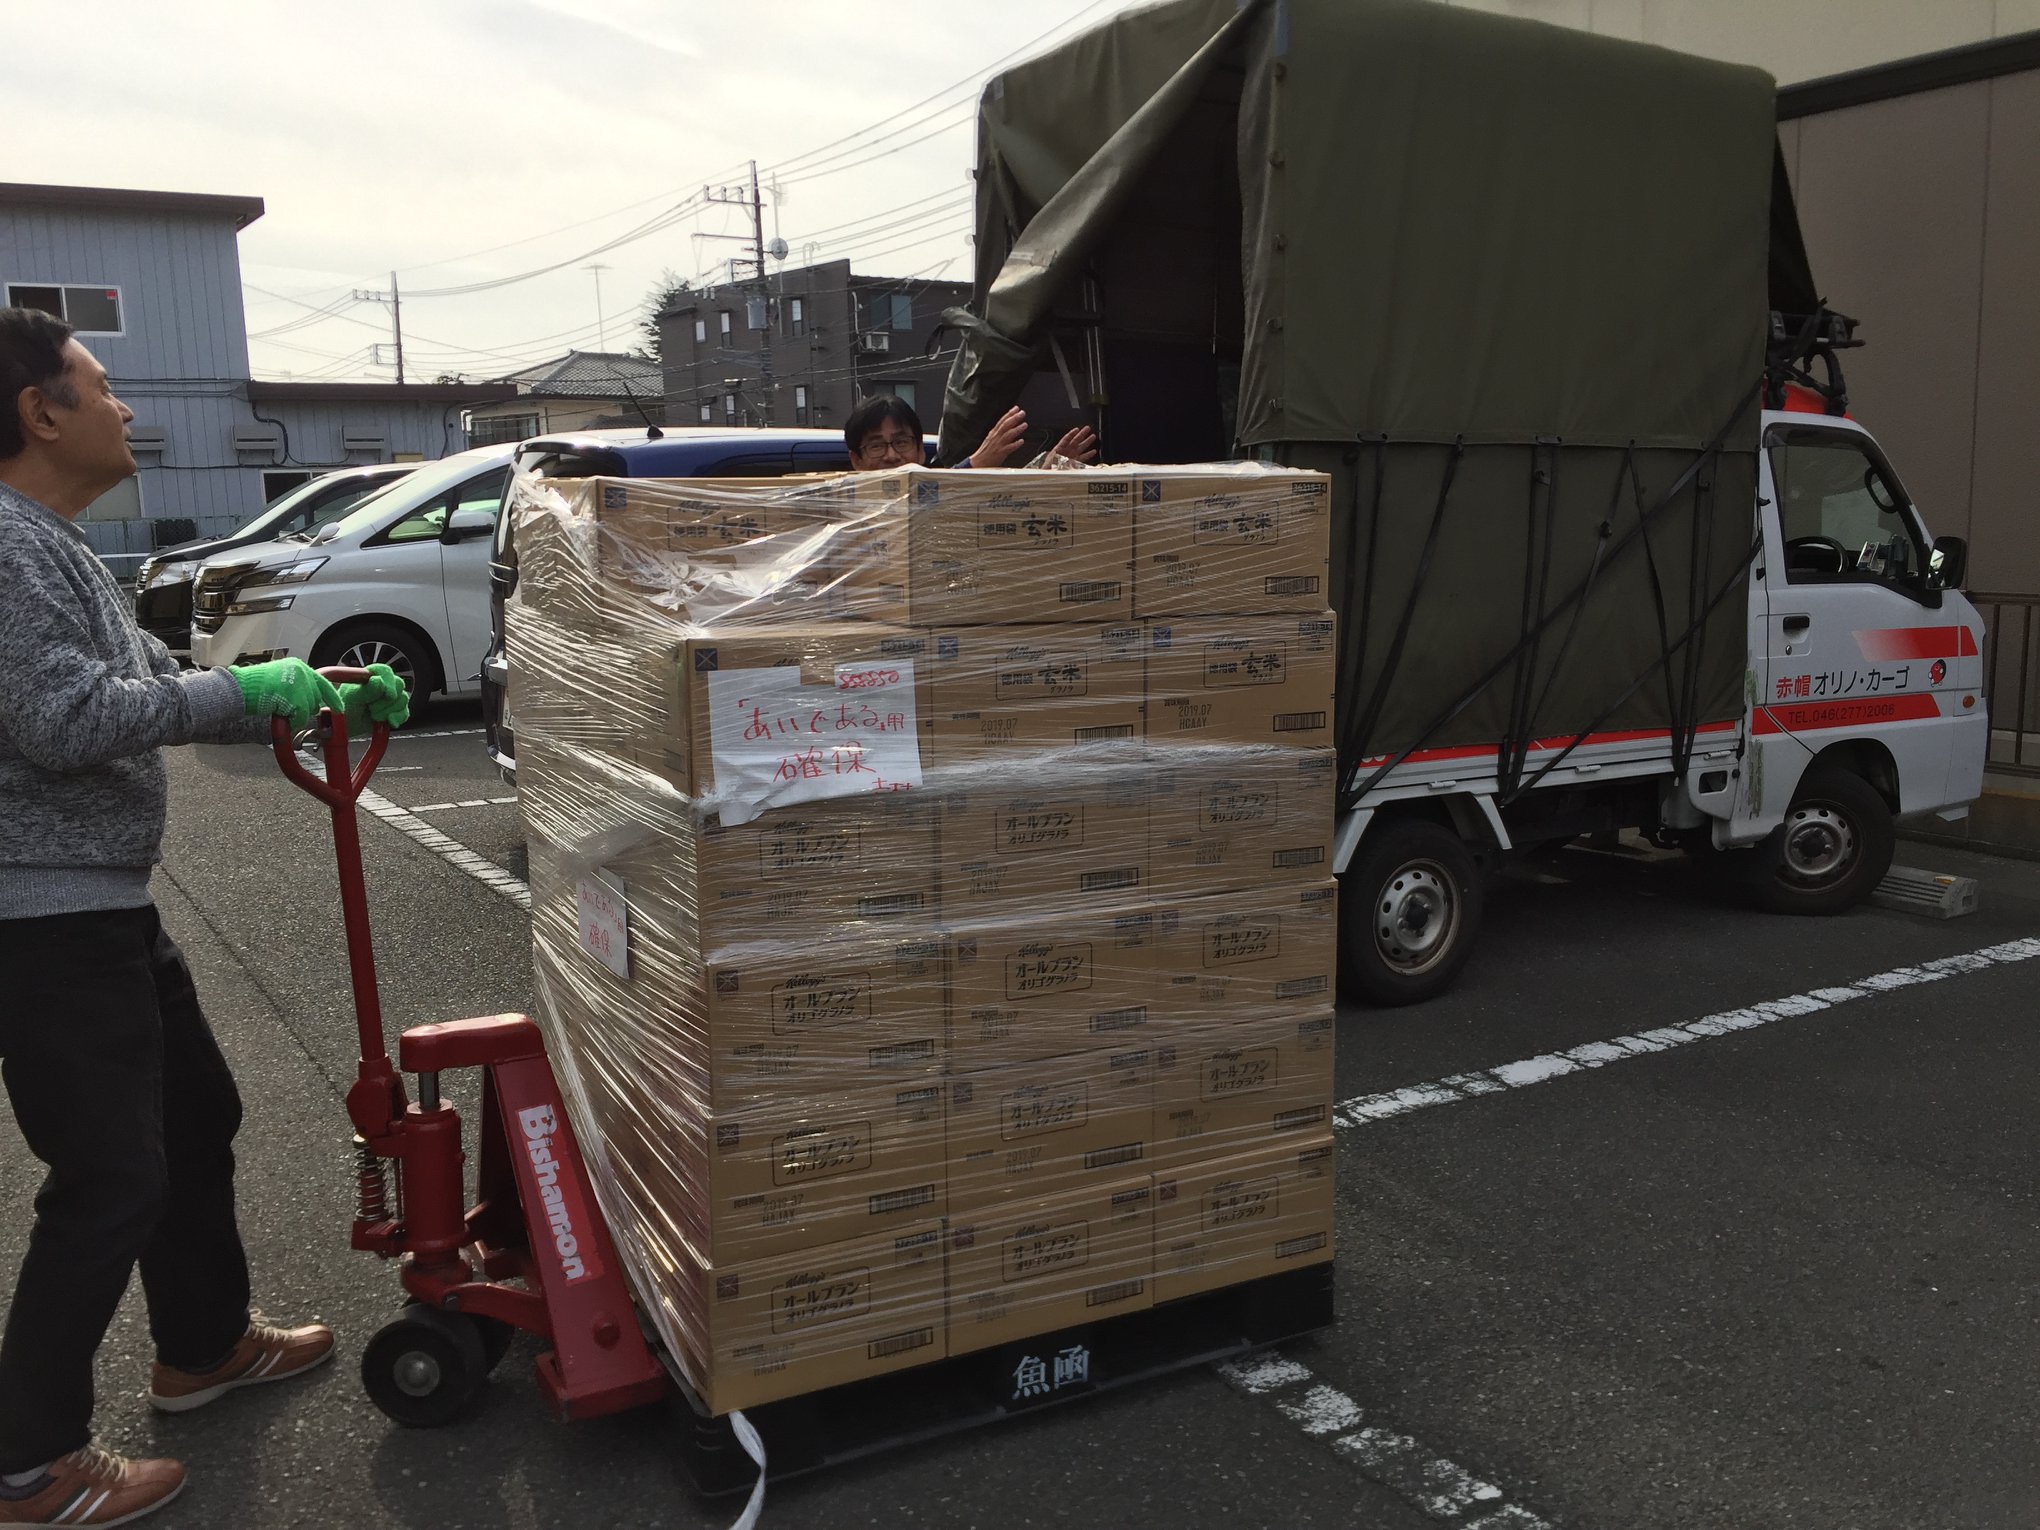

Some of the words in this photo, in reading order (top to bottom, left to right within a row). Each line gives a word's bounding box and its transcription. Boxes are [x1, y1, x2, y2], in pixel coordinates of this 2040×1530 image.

[1090, 483, 1128, 493] 36215-14
[1022, 512, 1068, 537] 玄米
[1233, 513, 1273, 534] 玄米
[1242, 652, 1282, 672] 玄米
[1037, 662, 1081, 685] 玄米
[1178, 703, 1212, 717] 2019.07
[981, 717, 1018, 731] 2019.07
[1016, 955, 1084, 978] オールブラン
[1017, 973, 1079, 991] オリゴグラノラ
[1210, 1059, 1269, 1081] オールブラン
[518, 1103, 585, 1281] Bishamon
[783, 1281, 861, 1308] オールブラン
